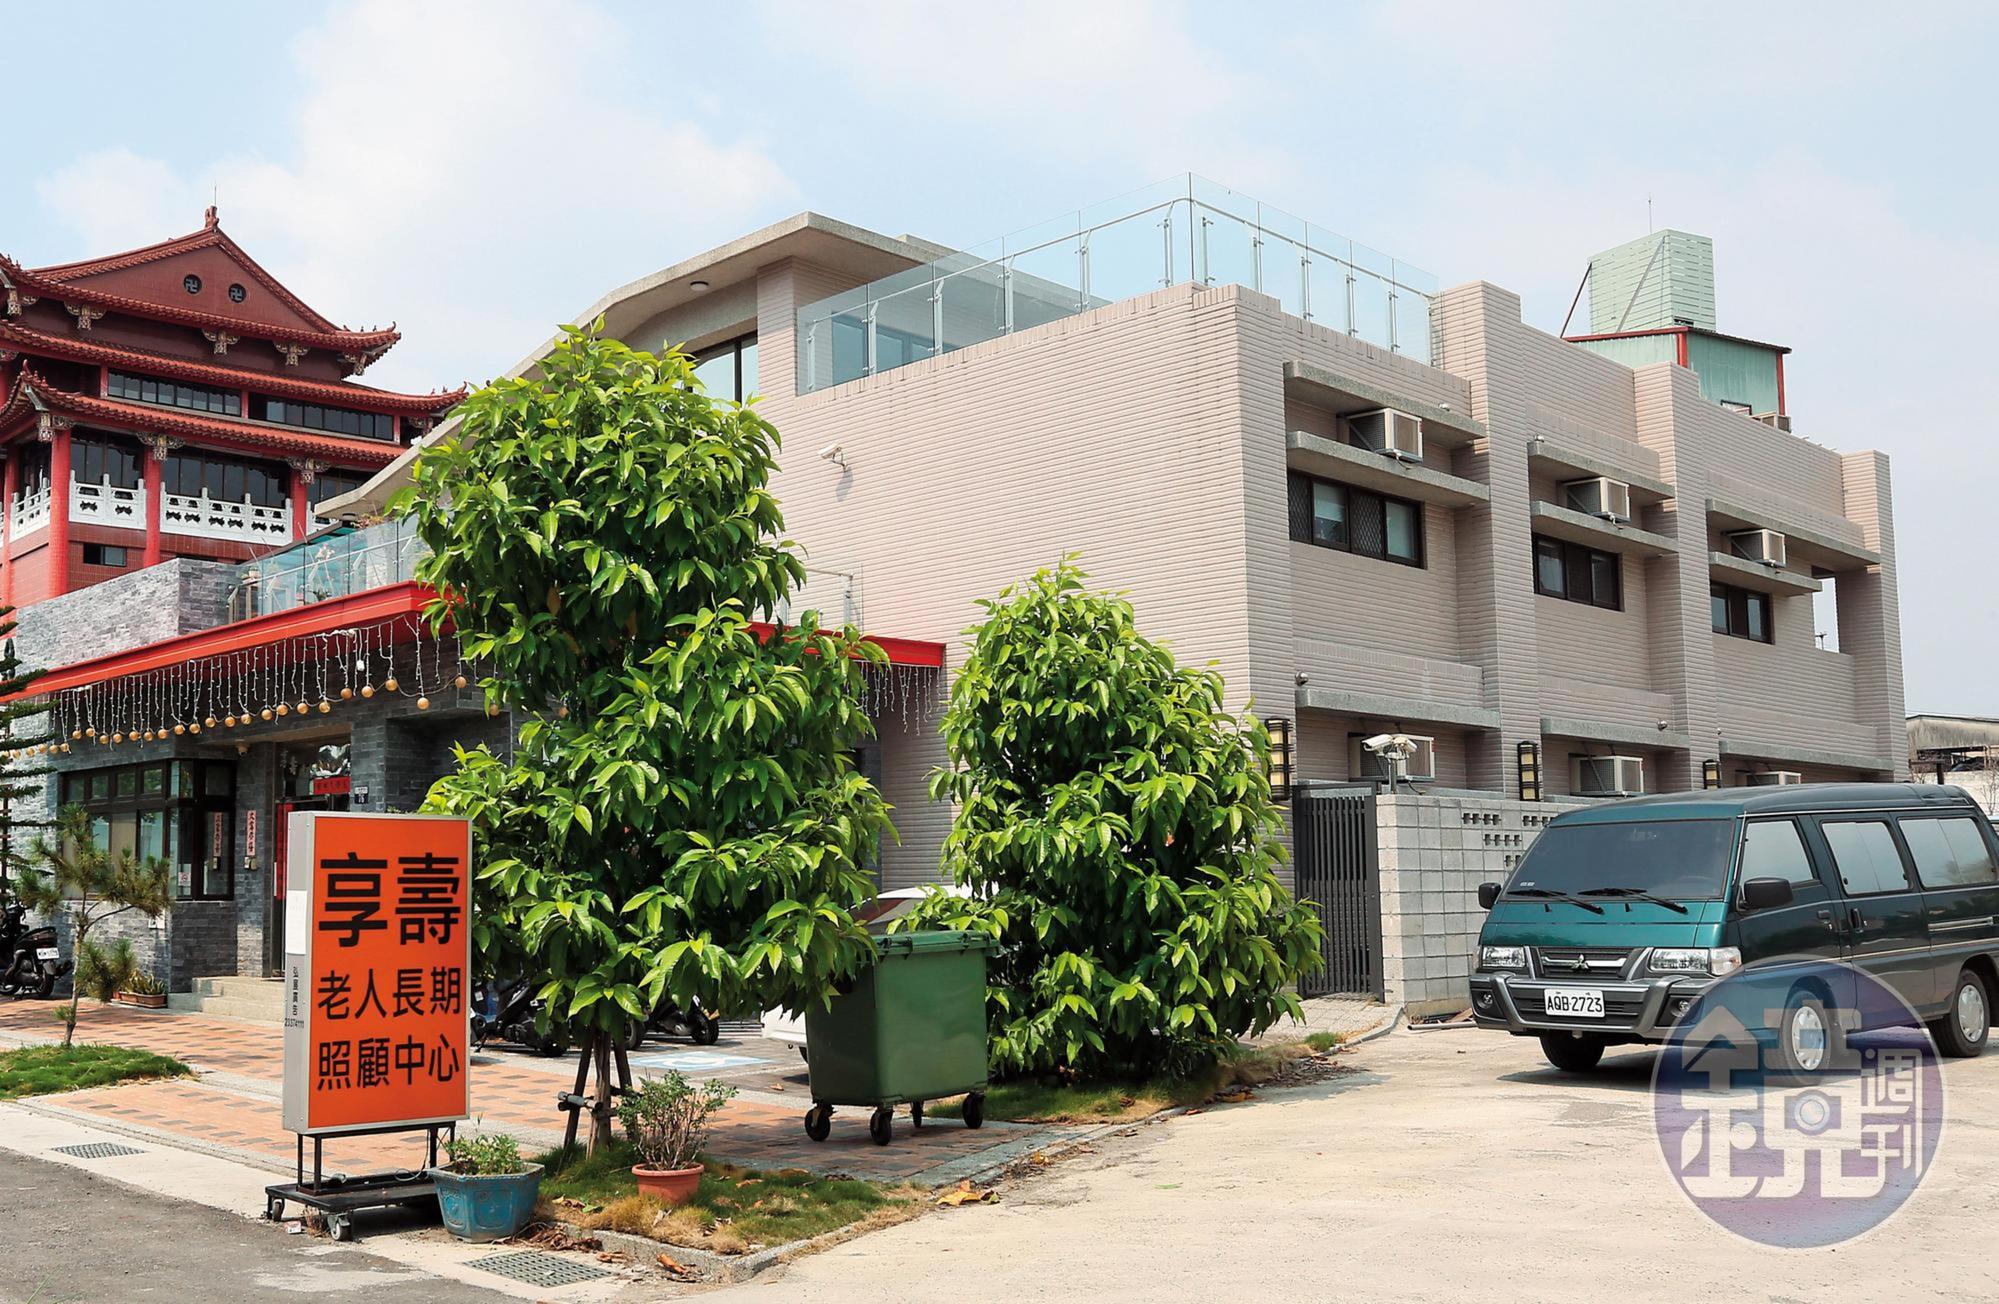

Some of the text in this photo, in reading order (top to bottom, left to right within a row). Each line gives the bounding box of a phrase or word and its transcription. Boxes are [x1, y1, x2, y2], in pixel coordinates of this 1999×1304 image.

[318, 851, 462, 948] 享壽
[317, 966, 462, 1021] 老人長期
[316, 1033, 461, 1091] 照顧中心
